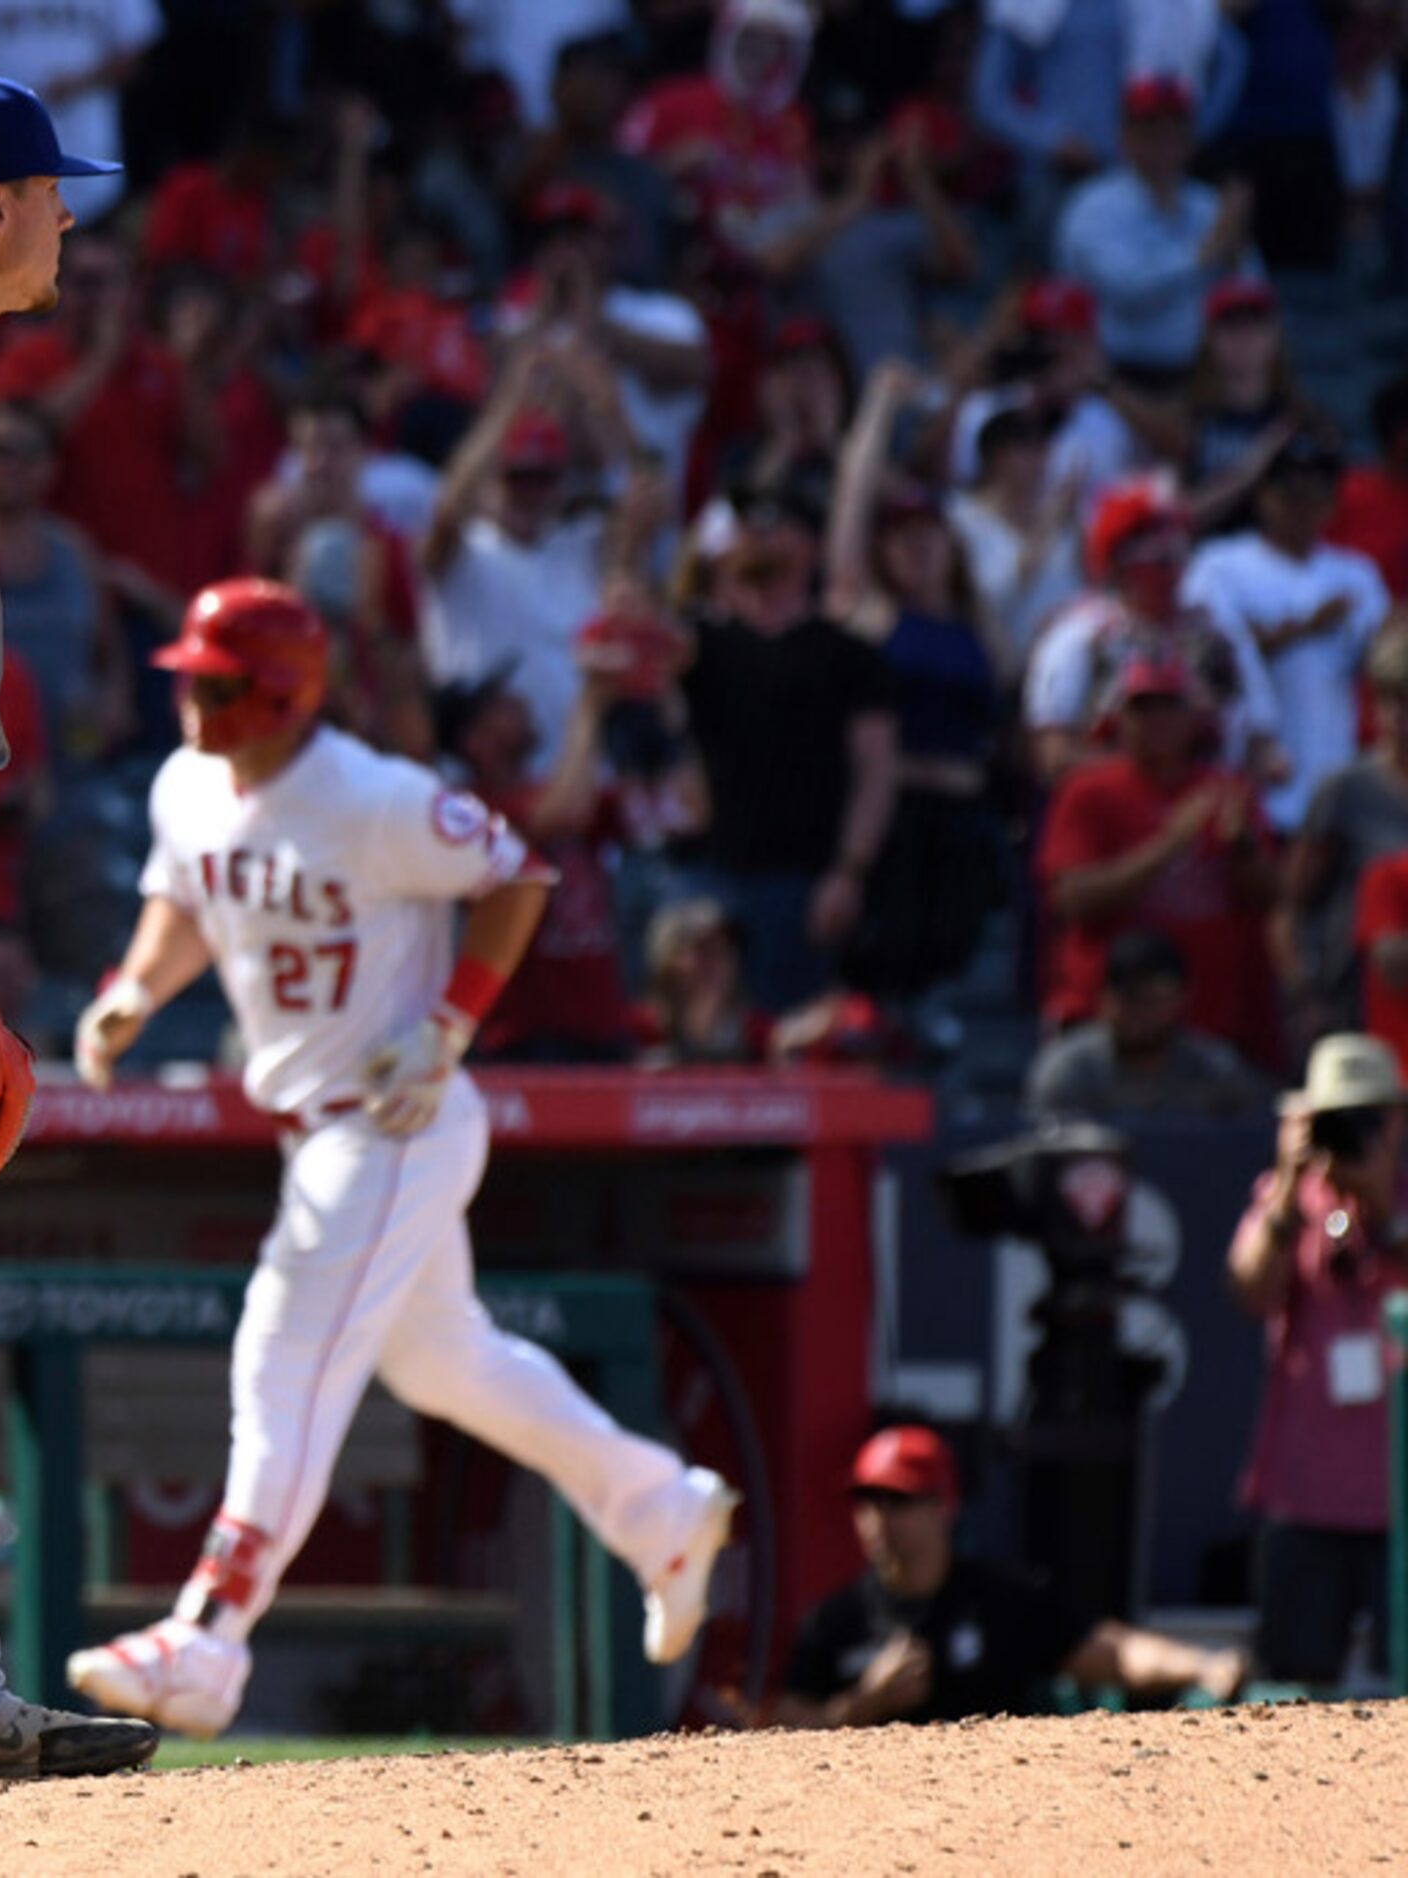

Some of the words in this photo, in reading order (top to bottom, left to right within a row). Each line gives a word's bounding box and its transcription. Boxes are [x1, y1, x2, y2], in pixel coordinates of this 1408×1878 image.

[269, 938, 360, 1014] 27
[56, 1087, 220, 1133] TOYOTA
[40, 1281, 229, 1333] TOYOTA
